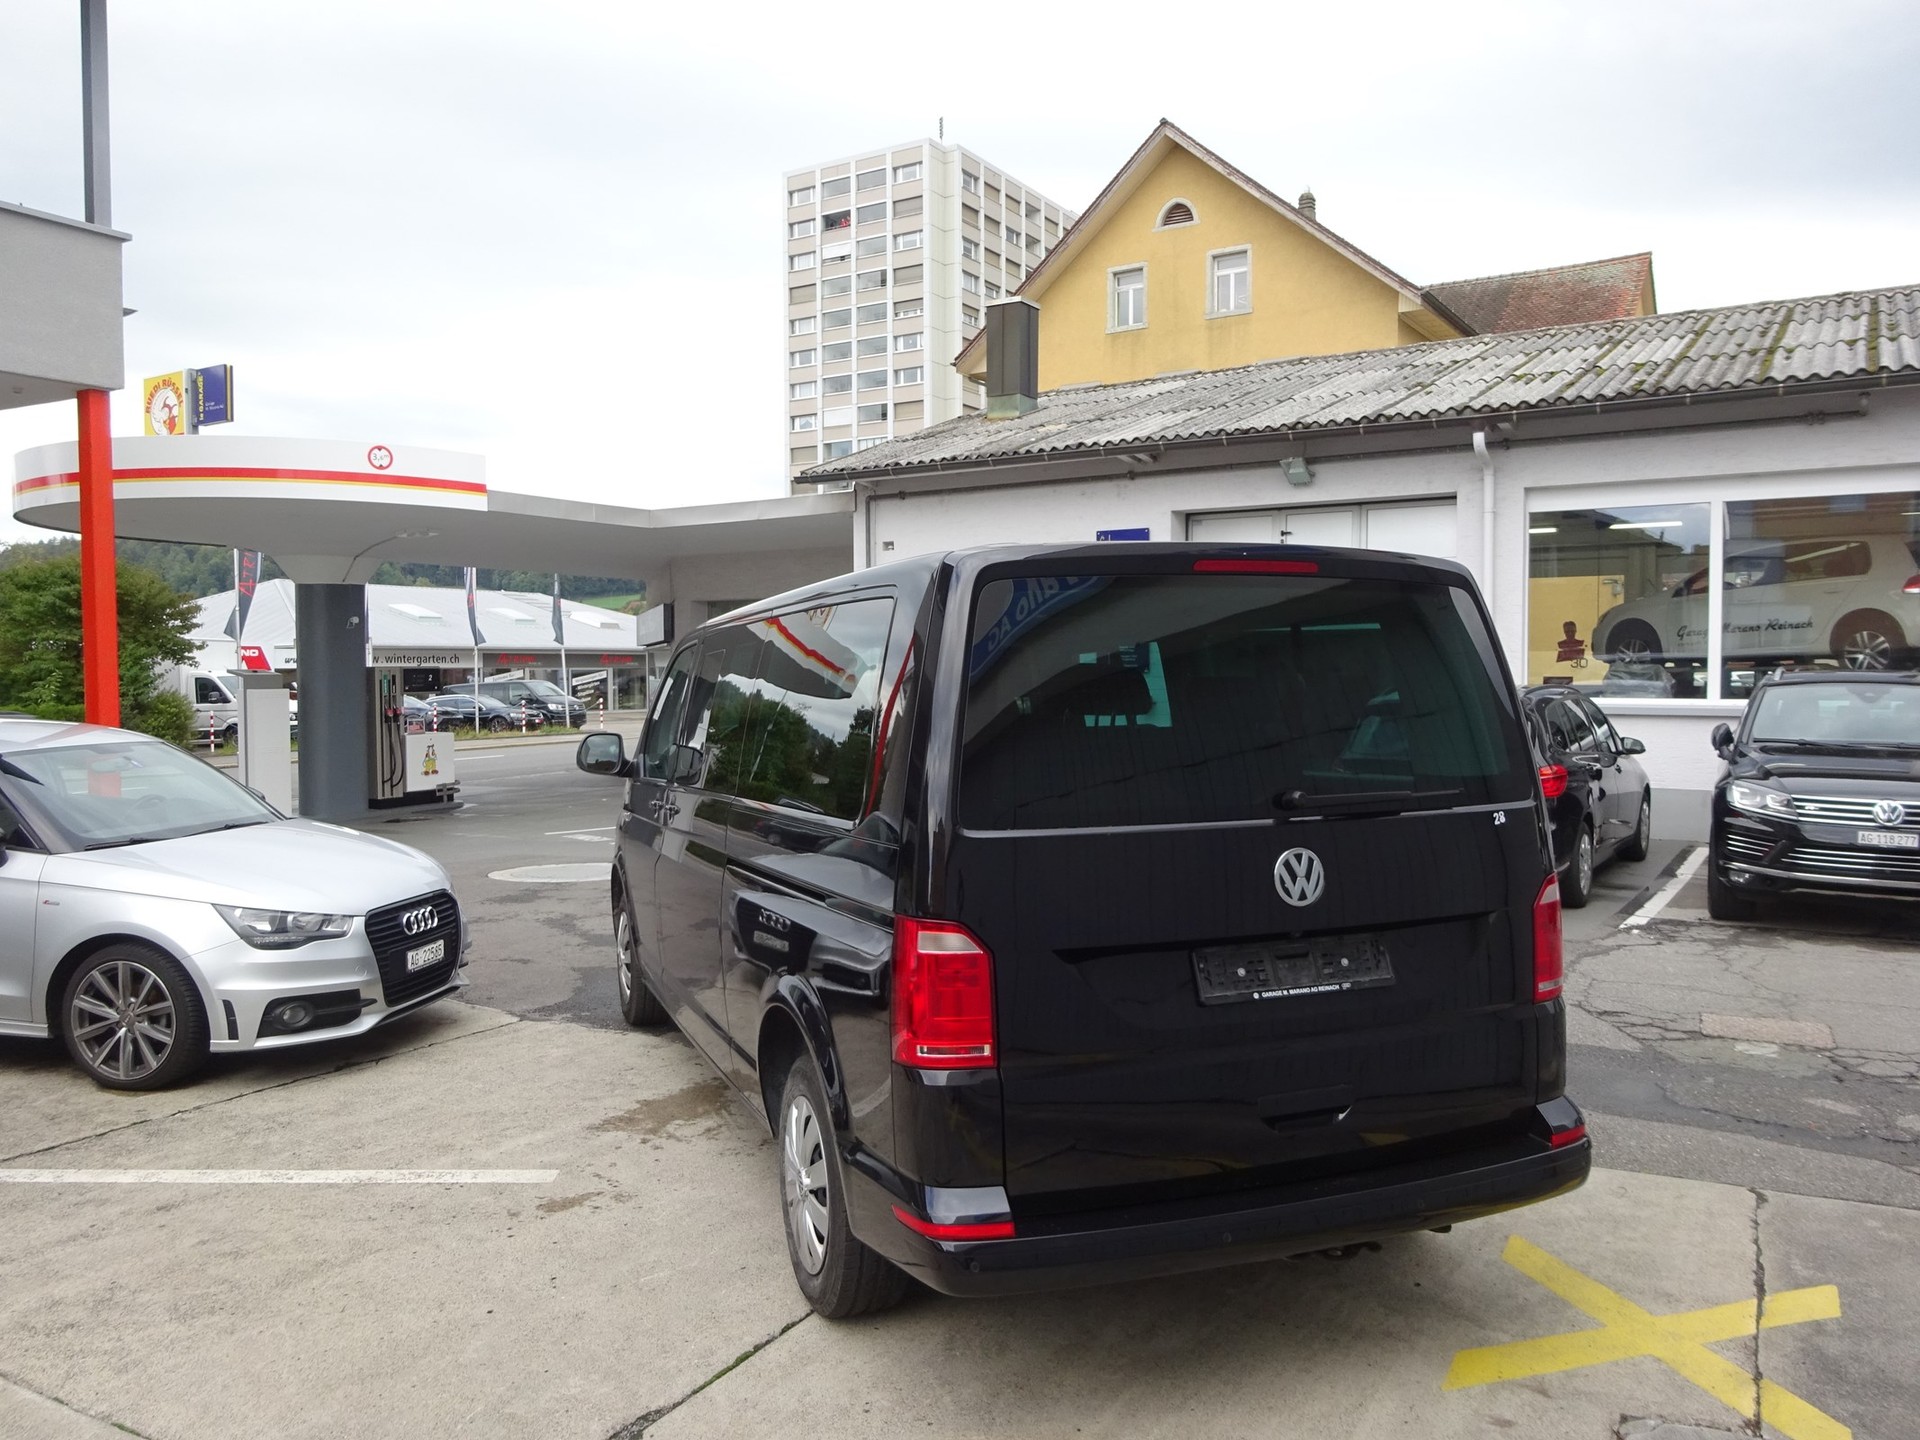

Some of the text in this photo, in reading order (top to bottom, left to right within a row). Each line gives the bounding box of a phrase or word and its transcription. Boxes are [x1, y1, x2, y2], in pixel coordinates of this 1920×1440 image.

[1764, 616, 1813, 631] Reinach
[1493, 811, 1506, 825] 28
[1861, 833, 1917, 846] AG 118277
[1261, 989, 1282, 998] GARAGE
[1289, 987, 1310, 995] MARANO
[1319, 984, 1340, 992] REINACH
